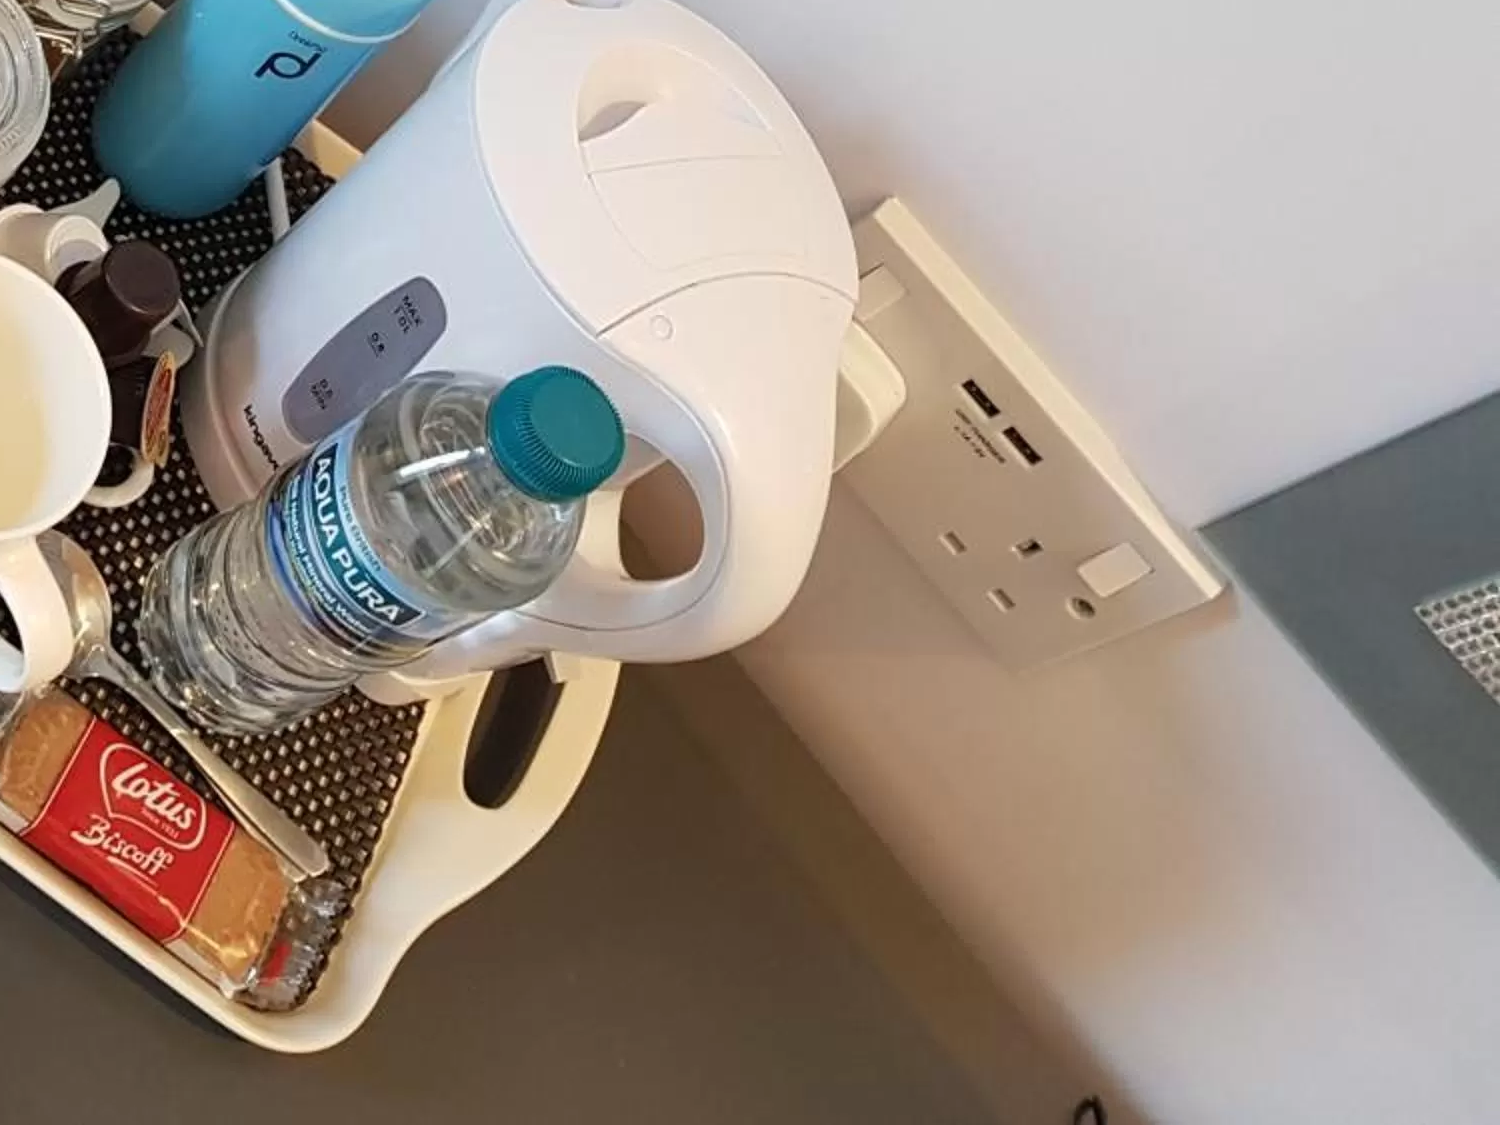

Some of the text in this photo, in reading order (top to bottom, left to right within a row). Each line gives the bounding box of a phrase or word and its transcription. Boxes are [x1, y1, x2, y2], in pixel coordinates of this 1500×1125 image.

[313, 456, 340, 548] AQUA
[332, 546, 401, 622] PURA
[111, 761, 197, 830] Lotus
[70, 814, 175, 876] Biscoff
